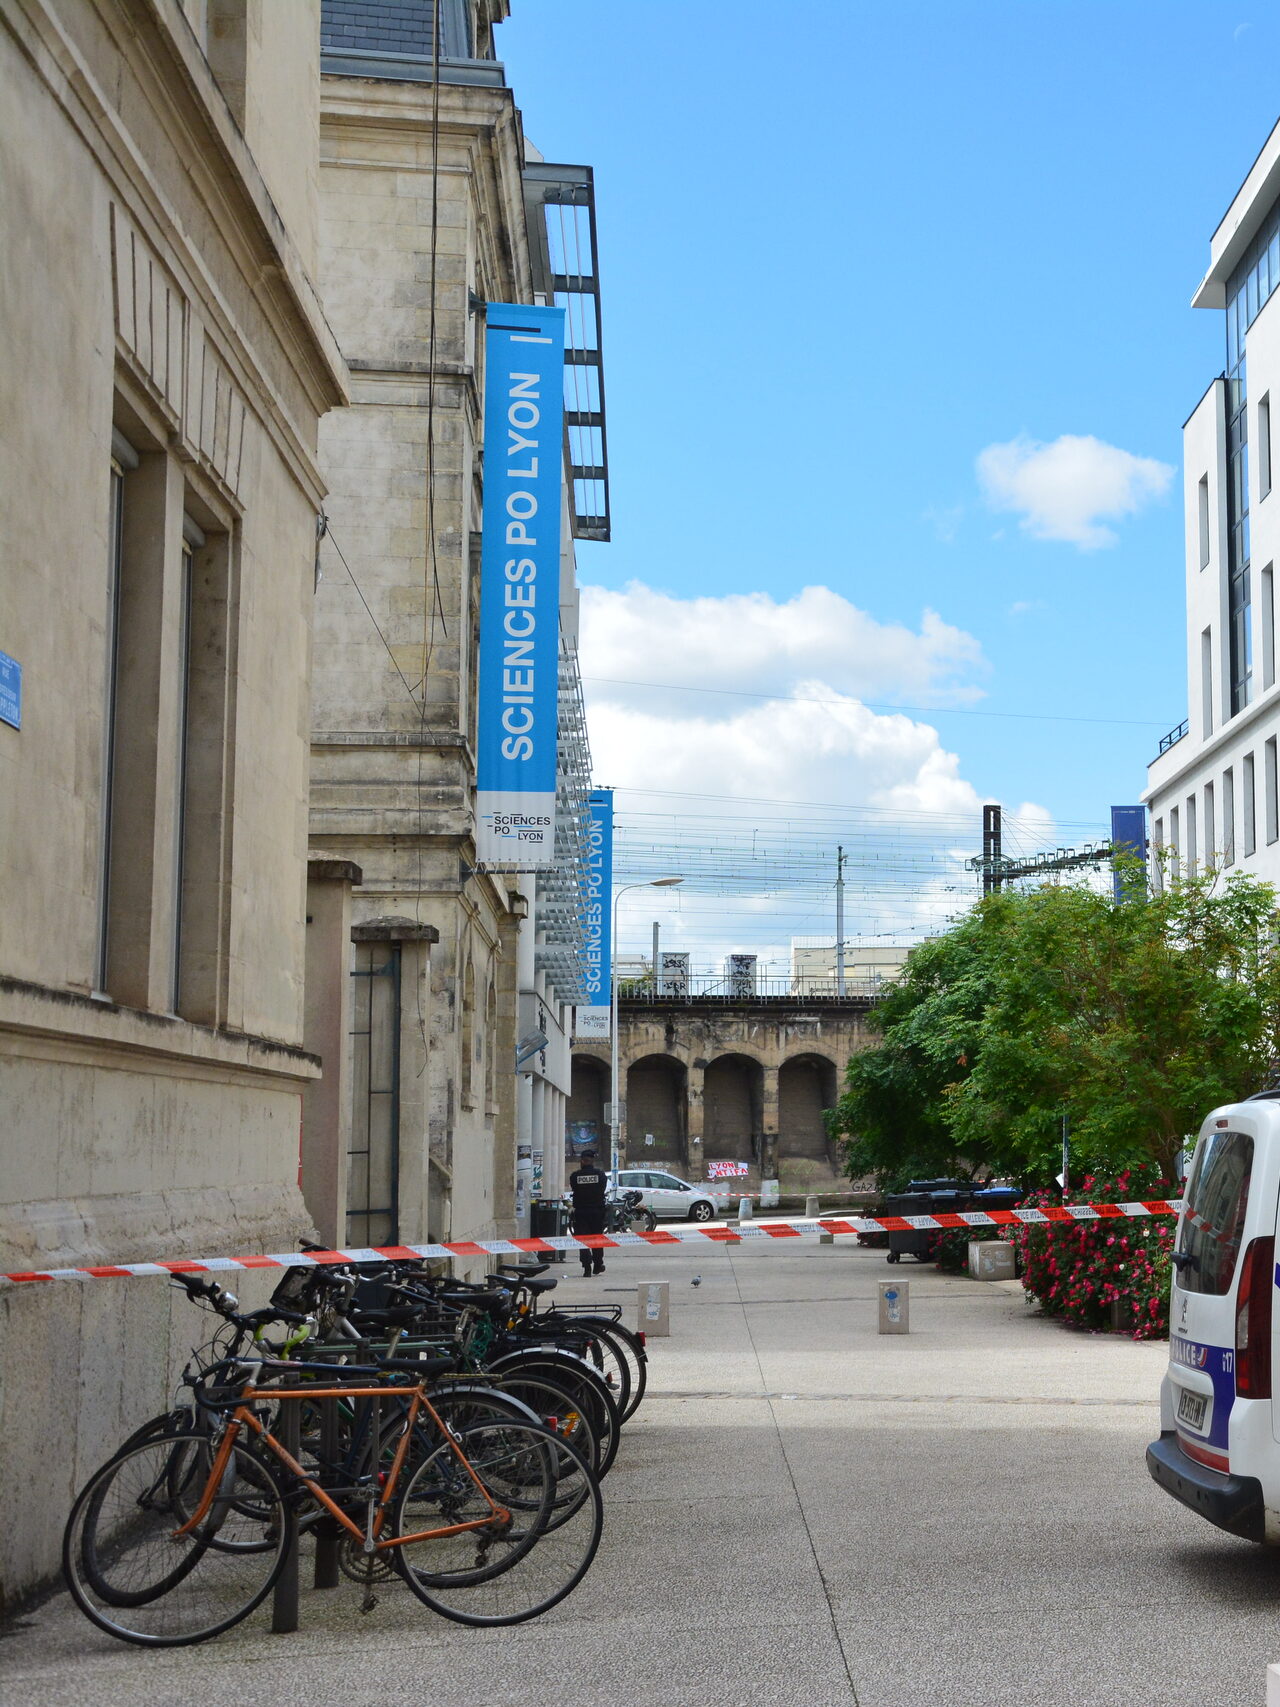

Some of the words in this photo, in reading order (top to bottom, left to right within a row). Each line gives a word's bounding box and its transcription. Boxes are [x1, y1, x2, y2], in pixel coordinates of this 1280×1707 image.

[507, 372, 541, 478] LYON
[506, 491, 538, 546] PO
[502, 558, 537, 762] SCIENCES
[494, 816, 551, 826] SCIENCES
[494, 826, 510, 835] PO
[518, 833, 544, 841] LYON
[589, 820, 604, 868] LYON
[588, 872, 603, 898] PO
[587, 903, 602, 993] SCIENCES
[710, 1162, 735, 1170] LYON
[577, 1175, 598, 1184] POLICE
[1226, 1352, 1233, 1373] 17
